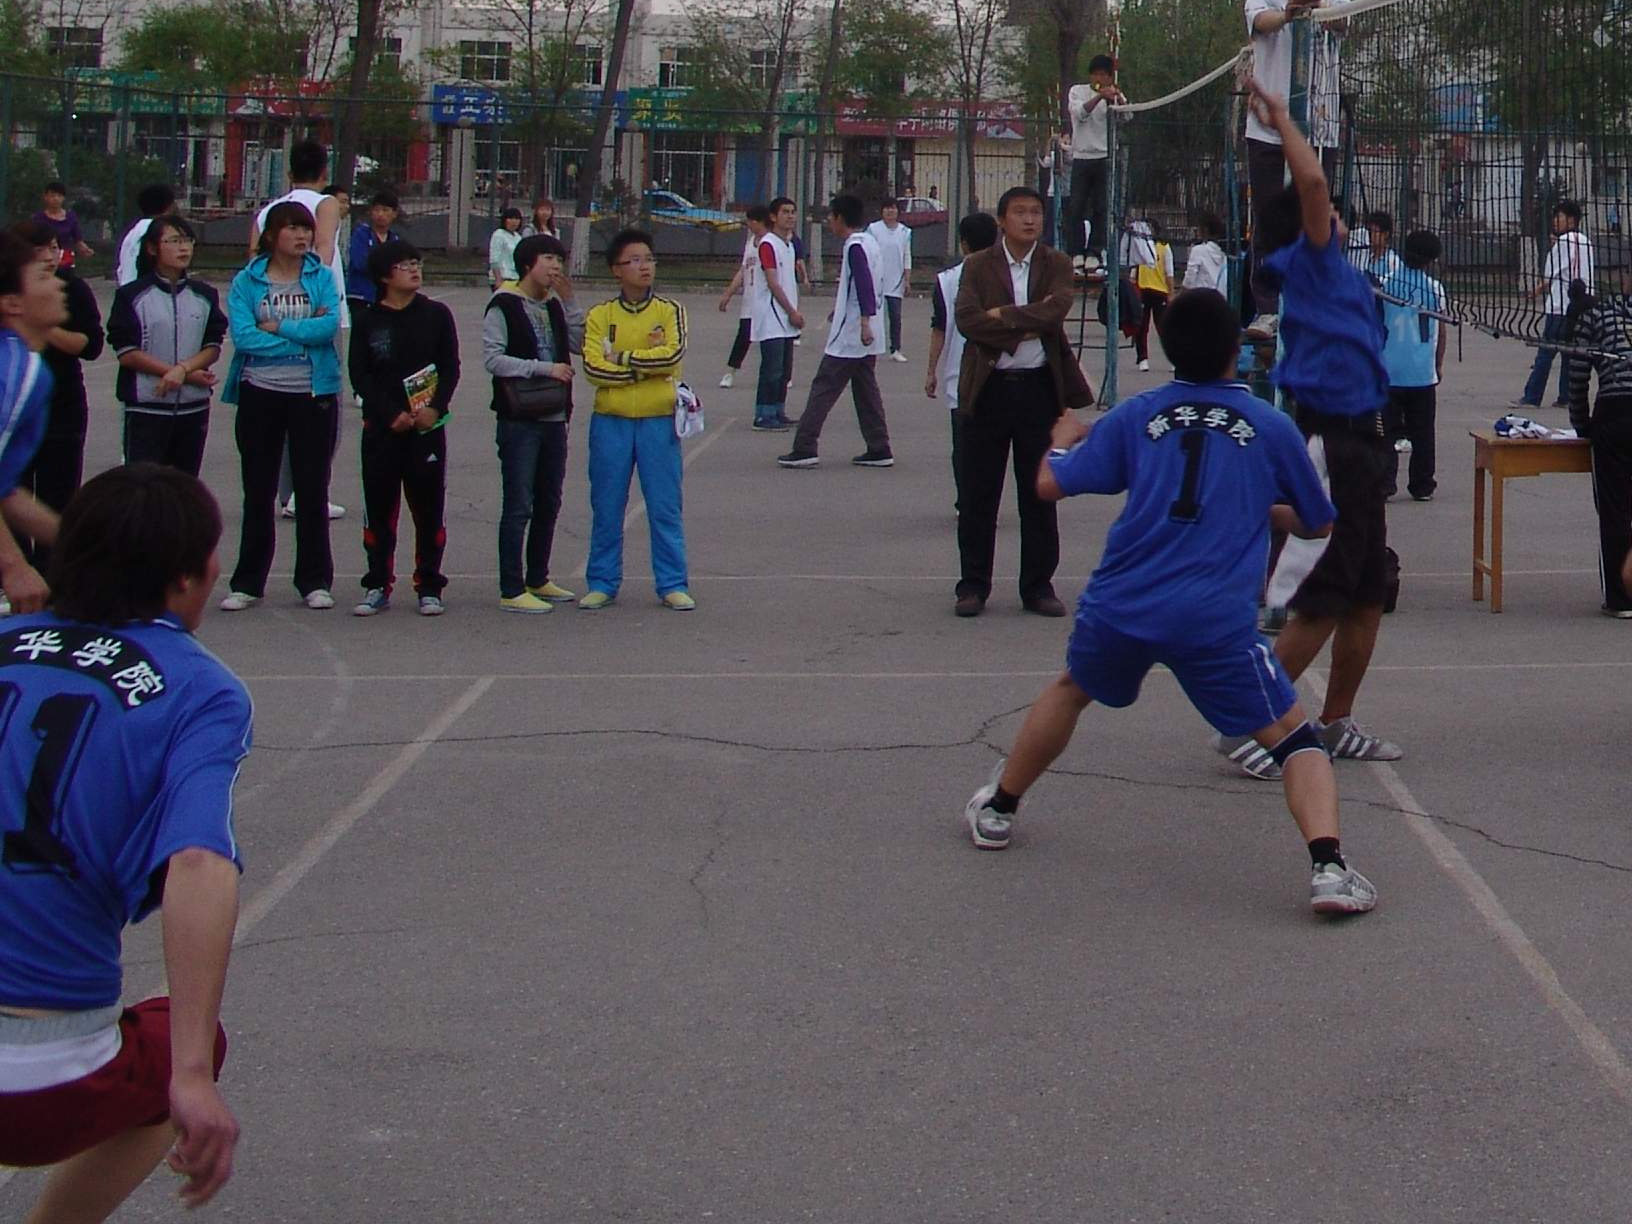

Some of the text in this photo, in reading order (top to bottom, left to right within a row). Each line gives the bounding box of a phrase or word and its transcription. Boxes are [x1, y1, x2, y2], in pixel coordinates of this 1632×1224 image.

[1147, 405, 1257, 446] 新华学院
[1169, 430, 1208, 523] 1
[13, 629, 165, 707] 华学院
